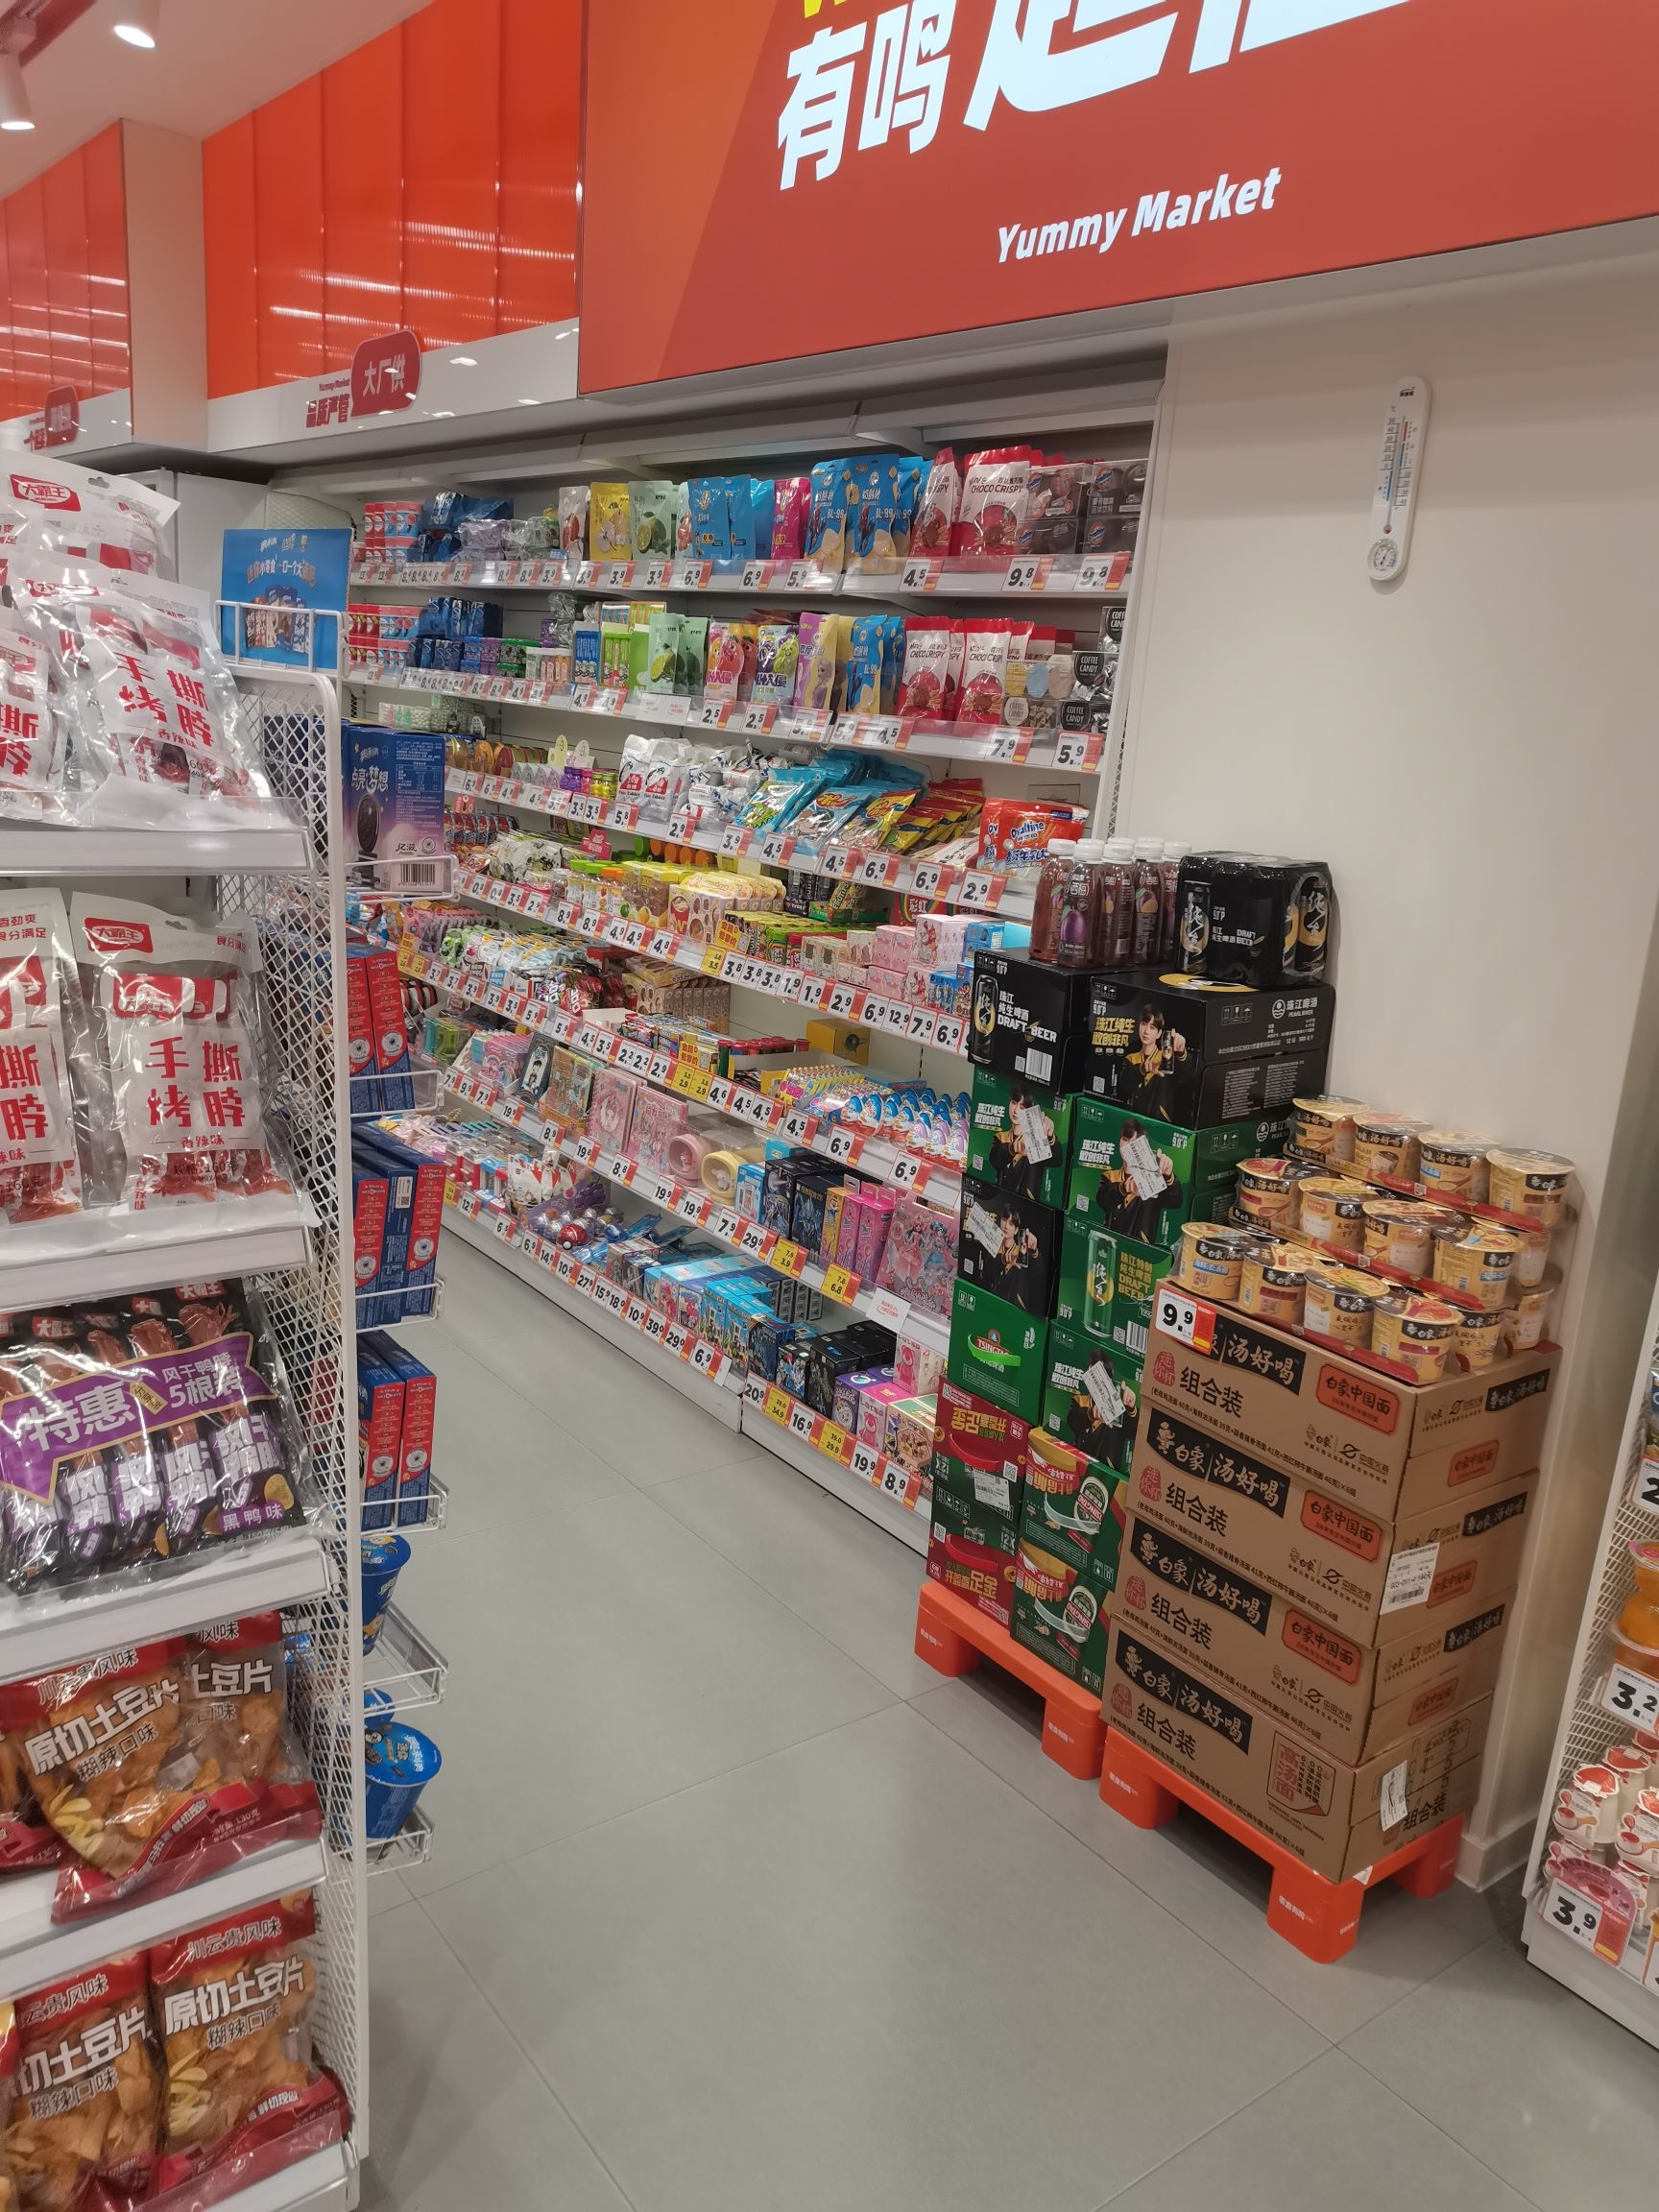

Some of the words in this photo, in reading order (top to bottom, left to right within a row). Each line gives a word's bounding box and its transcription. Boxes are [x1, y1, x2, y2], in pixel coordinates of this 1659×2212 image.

[997, 207, 1128, 264] Yummy
[1133, 166, 1281, 238] Market
[903, 569, 926, 588] 4.5
[1008, 566, 1034, 588] 9.8
[1079, 664, 1097, 673] CANDY
[1081, 656, 1099, 664] COFFEE
[1066, 714, 1084, 723] CANDY
[1067, 706, 1084, 715] COFFEE
[1057, 745, 1084, 765] 5.9
[1011, 821, 1045, 838] Ovaltine
[826, 856, 845, 872] 4.5
[865, 862, 886, 879] 6.9
[916, 872, 938, 890] 6.9
[963, 881, 989, 902] 2.9
[805, 985, 821, 1002] 1.9
[830, 995, 852, 1013] 2.9
[865, 1004, 885, 1022] 6.9
[912, 1017, 933, 1036] 7.9
[937, 1023, 958, 1044] 6.9
[998, 1015, 1028, 1033] DRAFT
[1031, 1025, 1057, 1043] BEER
[1094, 1016, 1135, 1033] 珠江纯生
[146, 1036, 242, 1084] 手撕
[147, 1085, 246, 1129] 烤脖
[787, 1118, 805, 1136] 4.5
[831, 1137, 850, 1156] 6.9
[895, 1162, 917, 1181] 6.9
[1118, 1274, 1151, 1290] DRAFT
[1118, 1284, 1144, 1300] BEER
[1162, 1302, 1194, 1334] 9.9
[162, 1352, 233, 1383] 风干鸭脖
[1227, 1333, 1295, 1386] 汤好喝
[1179, 1365, 1244, 1419] 组合装
[23, 1380, 136, 1453] 特惠
[792, 1412, 812, 1434] 16.9
[826, 1441, 840, 1455] 29.9
[854, 1453, 876, 1476] 19.9
[884, 1472, 906, 1495] 8.9
[1213, 1453, 1281, 1508] 汤好喝
[222, 1503, 284, 1531] 黑鸭味
[1166, 1481, 1229, 1538] 组合装
[1196, 1566, 1262, 1626] 汤好喝
[1151, 1592, 1214, 1650] 组合装
[1611, 1678, 1657, 1717] 3.2
[1180, 1685, 1245, 1744] 汤好喝
[25, 1678, 181, 1777] 原切土豆片
[1137, 1701, 1197, 1762] 组合装
[77, 1720, 158, 1783] 糊辣口味
[1553, 1895, 1597, 1935] 3.9
[187, 1916, 283, 1963] 川云贵风味
[164, 1956, 307, 2037] 原切土豆片
[206, 2003, 282, 2052] 糊辣口味
